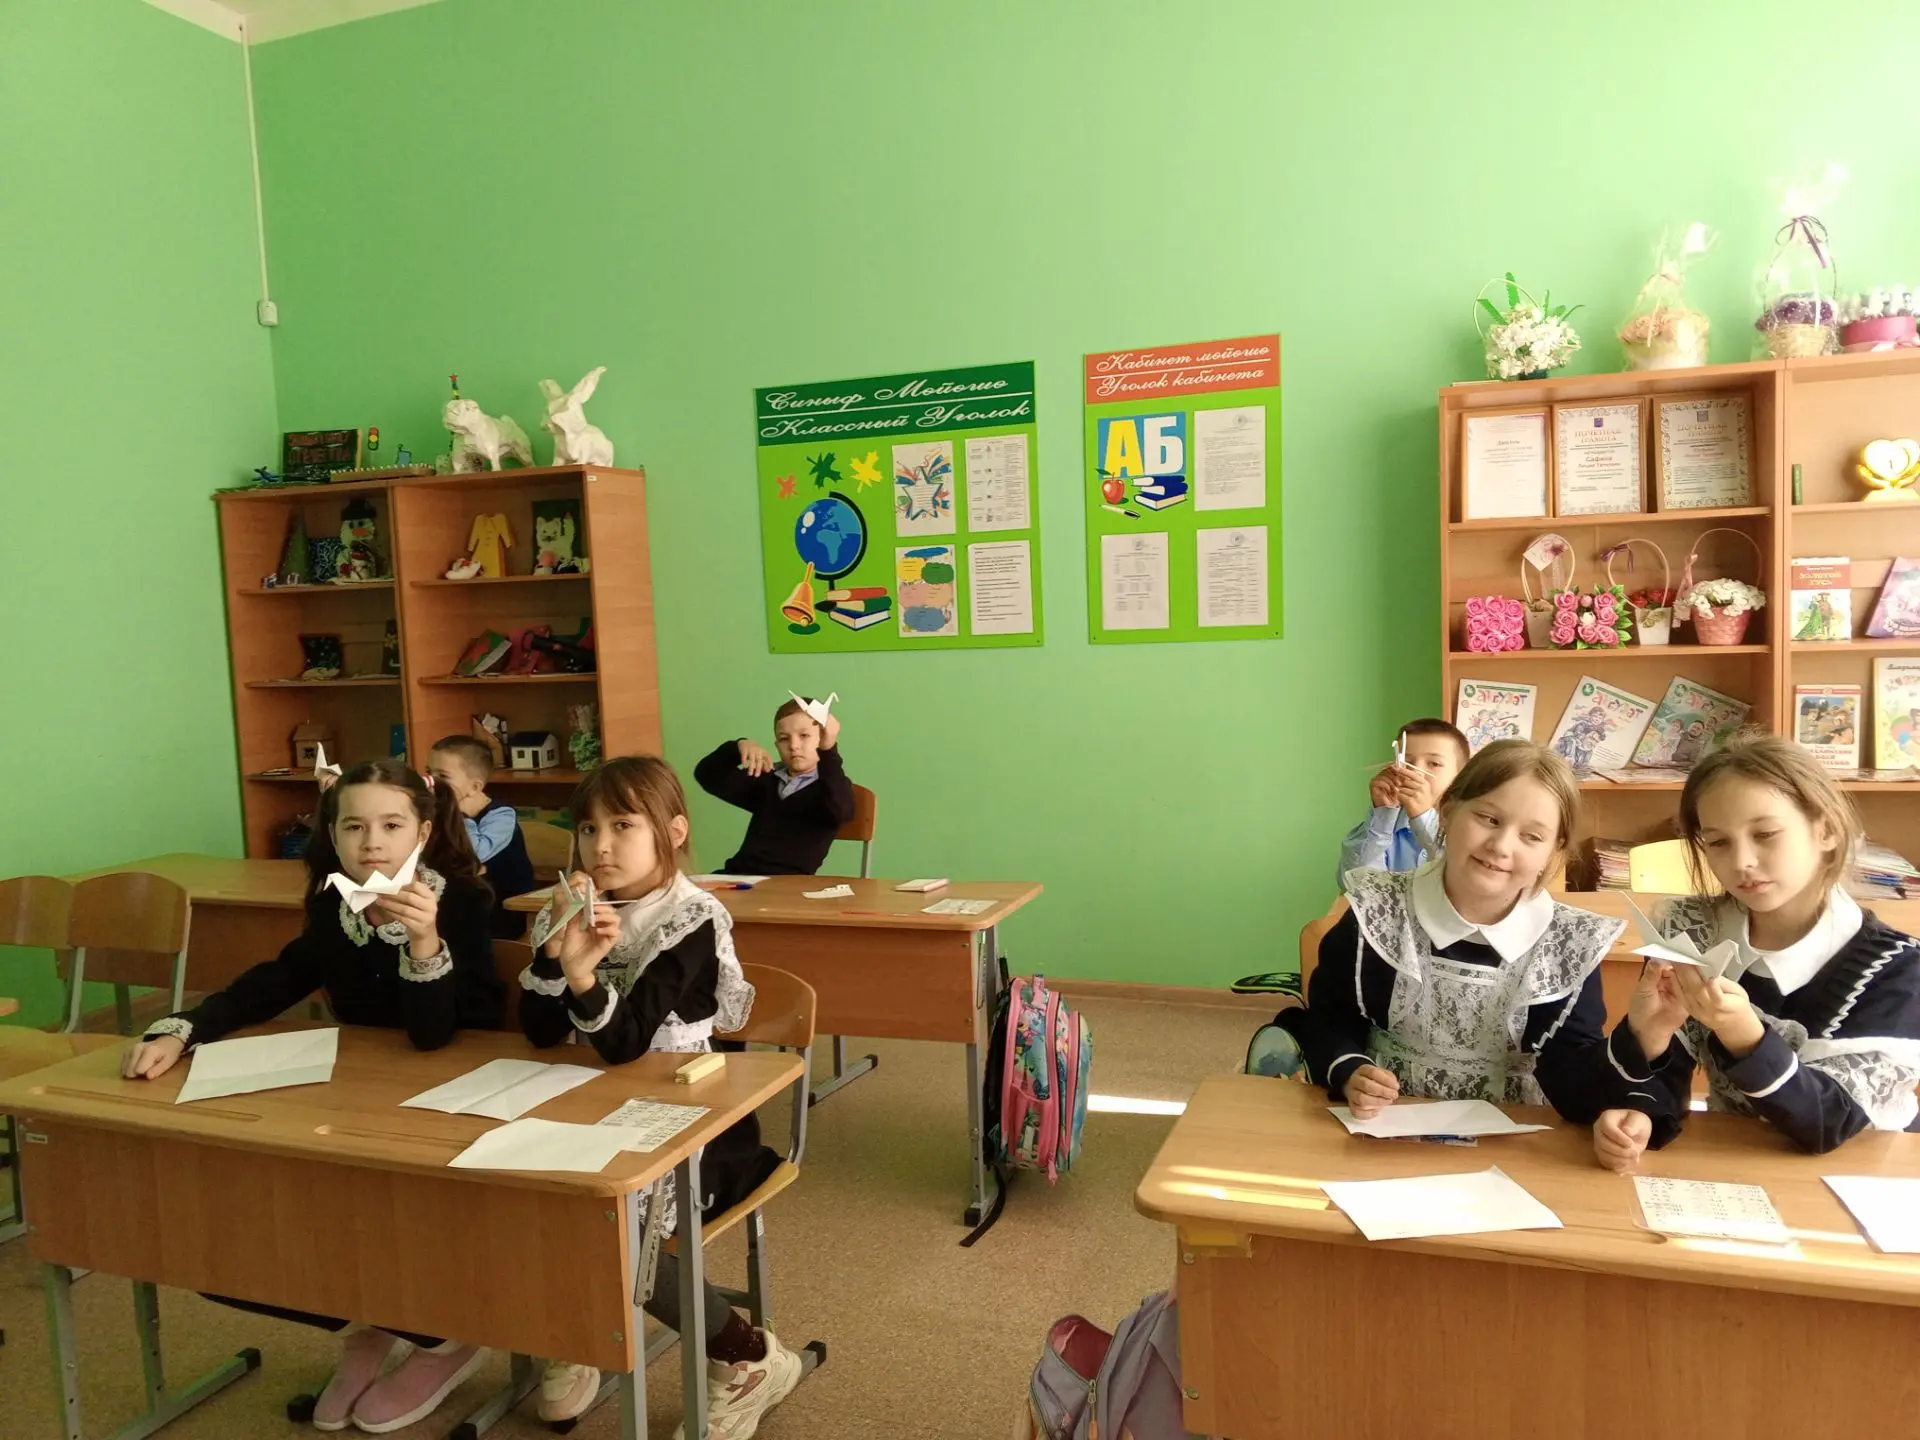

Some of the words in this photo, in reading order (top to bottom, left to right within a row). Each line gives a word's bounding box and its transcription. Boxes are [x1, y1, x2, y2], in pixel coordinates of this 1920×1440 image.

[1096, 373, 1169, 397] Уголок
[1172, 368, 1265, 387] кабинета
[765, 391, 866, 412] Синыф
[761, 415, 910, 438] Классный
[916, 400, 1031, 427] Уголок
[1102, 415, 1186, 478] АБ
